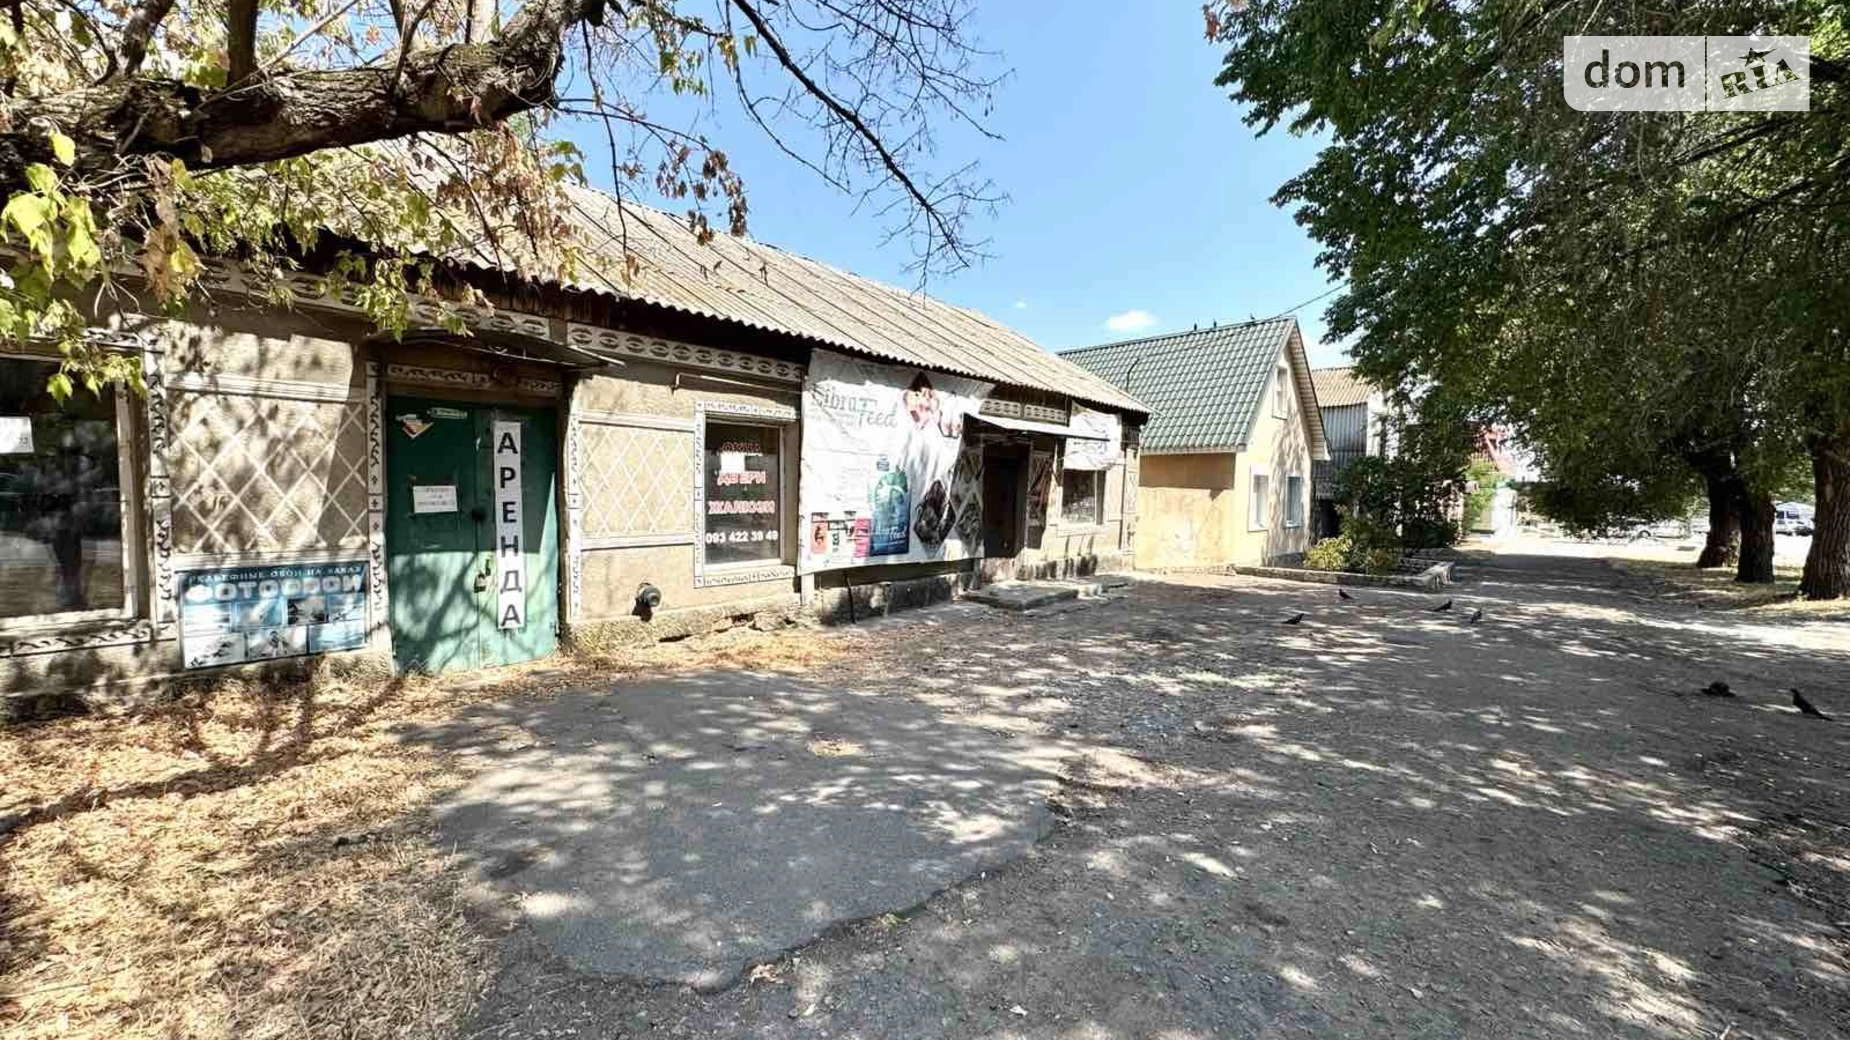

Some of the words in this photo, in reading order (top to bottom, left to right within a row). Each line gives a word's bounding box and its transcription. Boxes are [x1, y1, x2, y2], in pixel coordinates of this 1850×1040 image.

[717, 471, 766, 485] ДВЕРИ
[708, 501, 776, 514] ЖАЛЮЗИ
[497, 432, 521, 626] АРЕНДА
[705, 532, 726, 543] 093
[729, 531, 749, 542] 422
